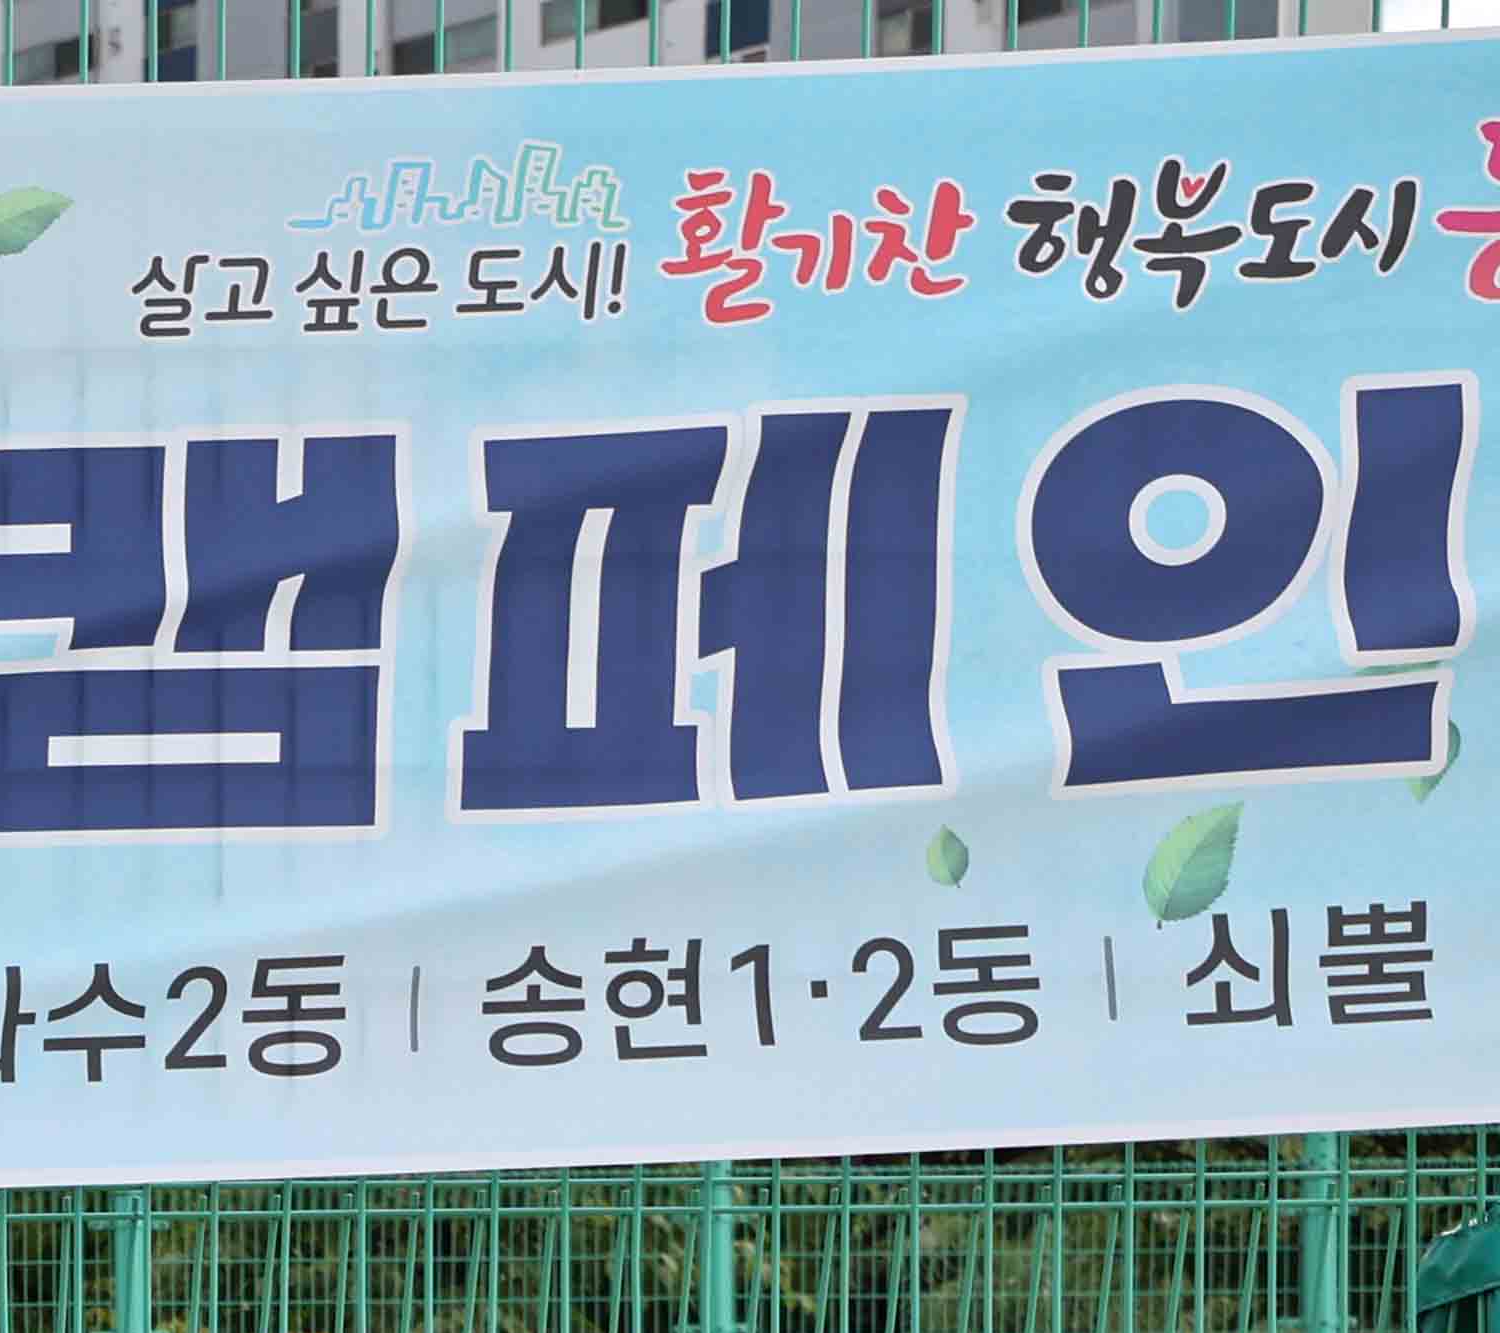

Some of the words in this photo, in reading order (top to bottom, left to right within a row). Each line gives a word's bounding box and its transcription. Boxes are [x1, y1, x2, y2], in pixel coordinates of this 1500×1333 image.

[132, 256, 272, 336] 살고
[297, 248, 438, 331] 싶은
[457, 242, 625, 319] 도시!
[664, 173, 972, 321] 활기찬
[1008, 160, 1416, 308] 행복도시
[1187, 902, 1433, 1026] 쇠뿔
